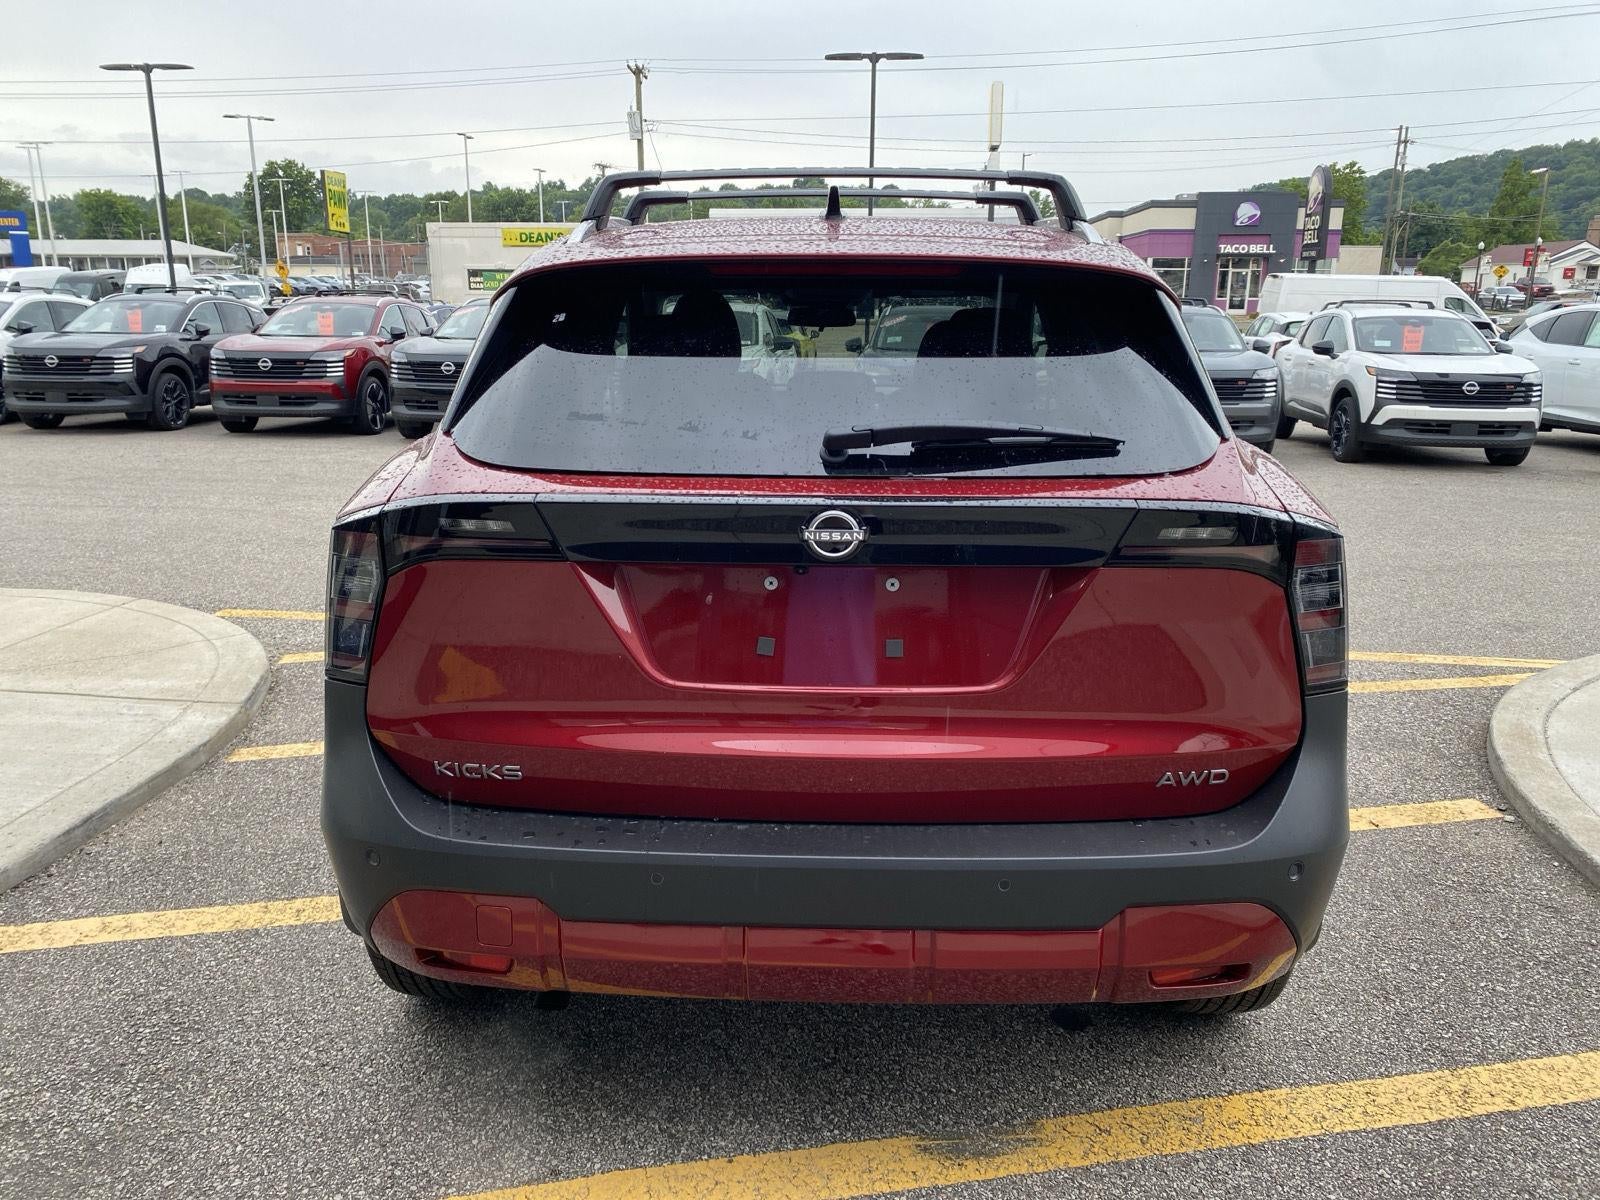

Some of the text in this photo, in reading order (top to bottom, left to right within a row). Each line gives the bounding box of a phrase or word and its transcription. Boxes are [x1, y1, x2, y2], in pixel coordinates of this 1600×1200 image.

[328, 189, 346, 210] PAWN
[1304, 216, 1320, 230] TACO
[1302, 230, 1318, 244] BELL
[1219, 244, 1276, 254] TACO BELL
[804, 531, 863, 541] NISSAN
[433, 760, 523, 780] KICKS
[1155, 768, 1230, 787] AWD
